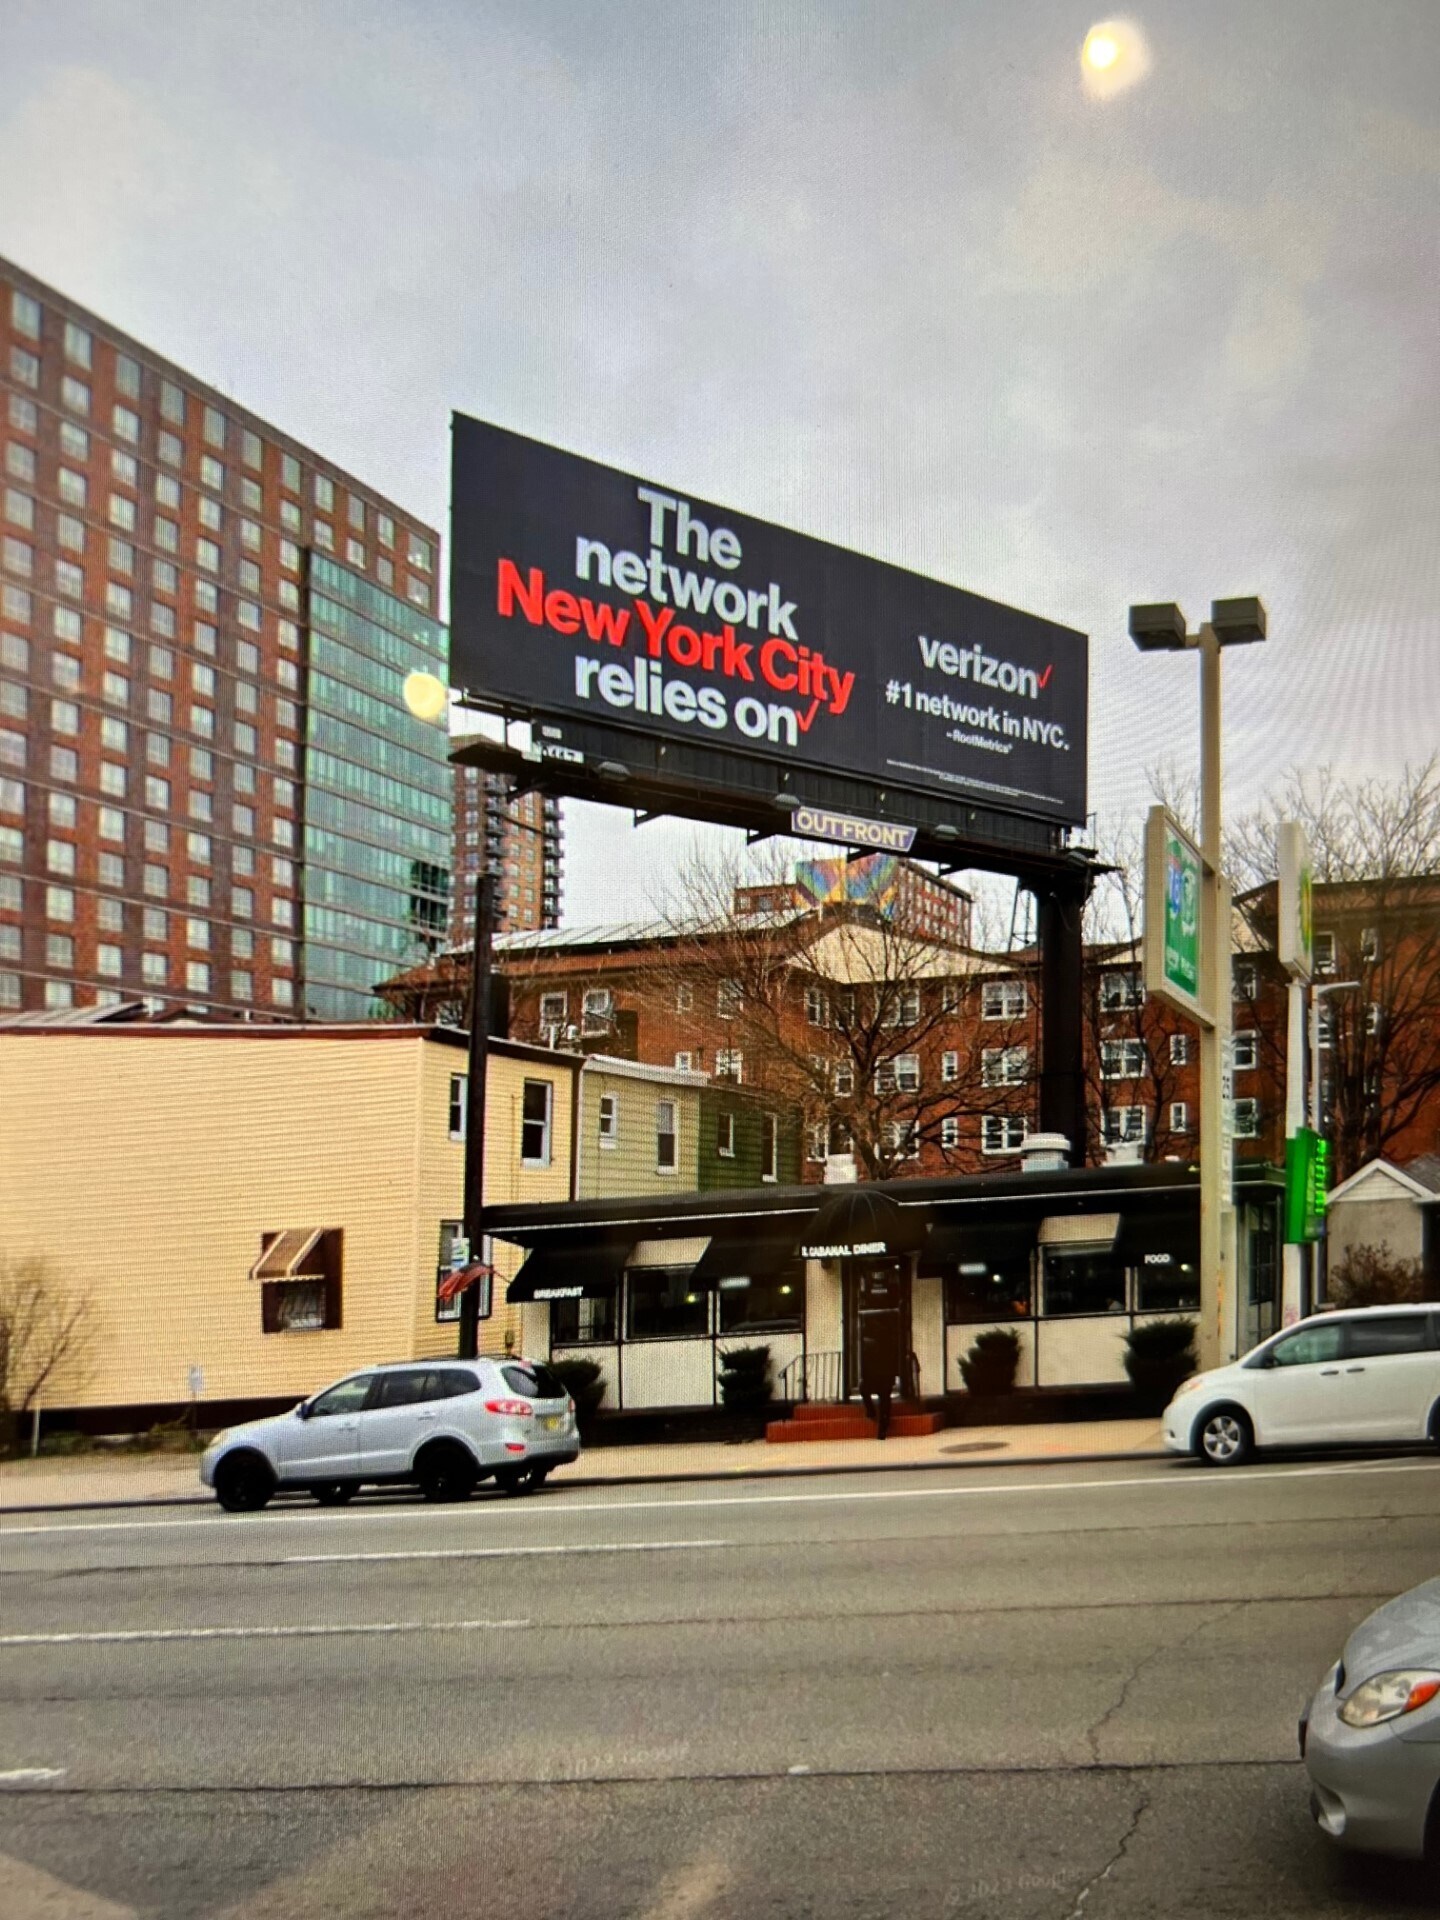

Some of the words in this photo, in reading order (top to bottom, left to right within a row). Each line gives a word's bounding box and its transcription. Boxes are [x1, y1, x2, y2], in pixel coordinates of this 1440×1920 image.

[637, 486, 742, 570] The
[575, 536, 799, 641] network
[497, 558, 631, 648] New
[633, 599, 755, 682] York
[760, 638, 856, 717] City
[918, 635, 1039, 699] verizon
[575, 655, 727, 731] relies
[734, 701, 799, 747] on
[884, 680, 912, 709] #1
[915, 689, 1001, 733] network
[1002, 710, 1020, 738] in
[1022, 717, 1071, 751] NYC.
[796, 809, 909, 848] OUTFRONT
